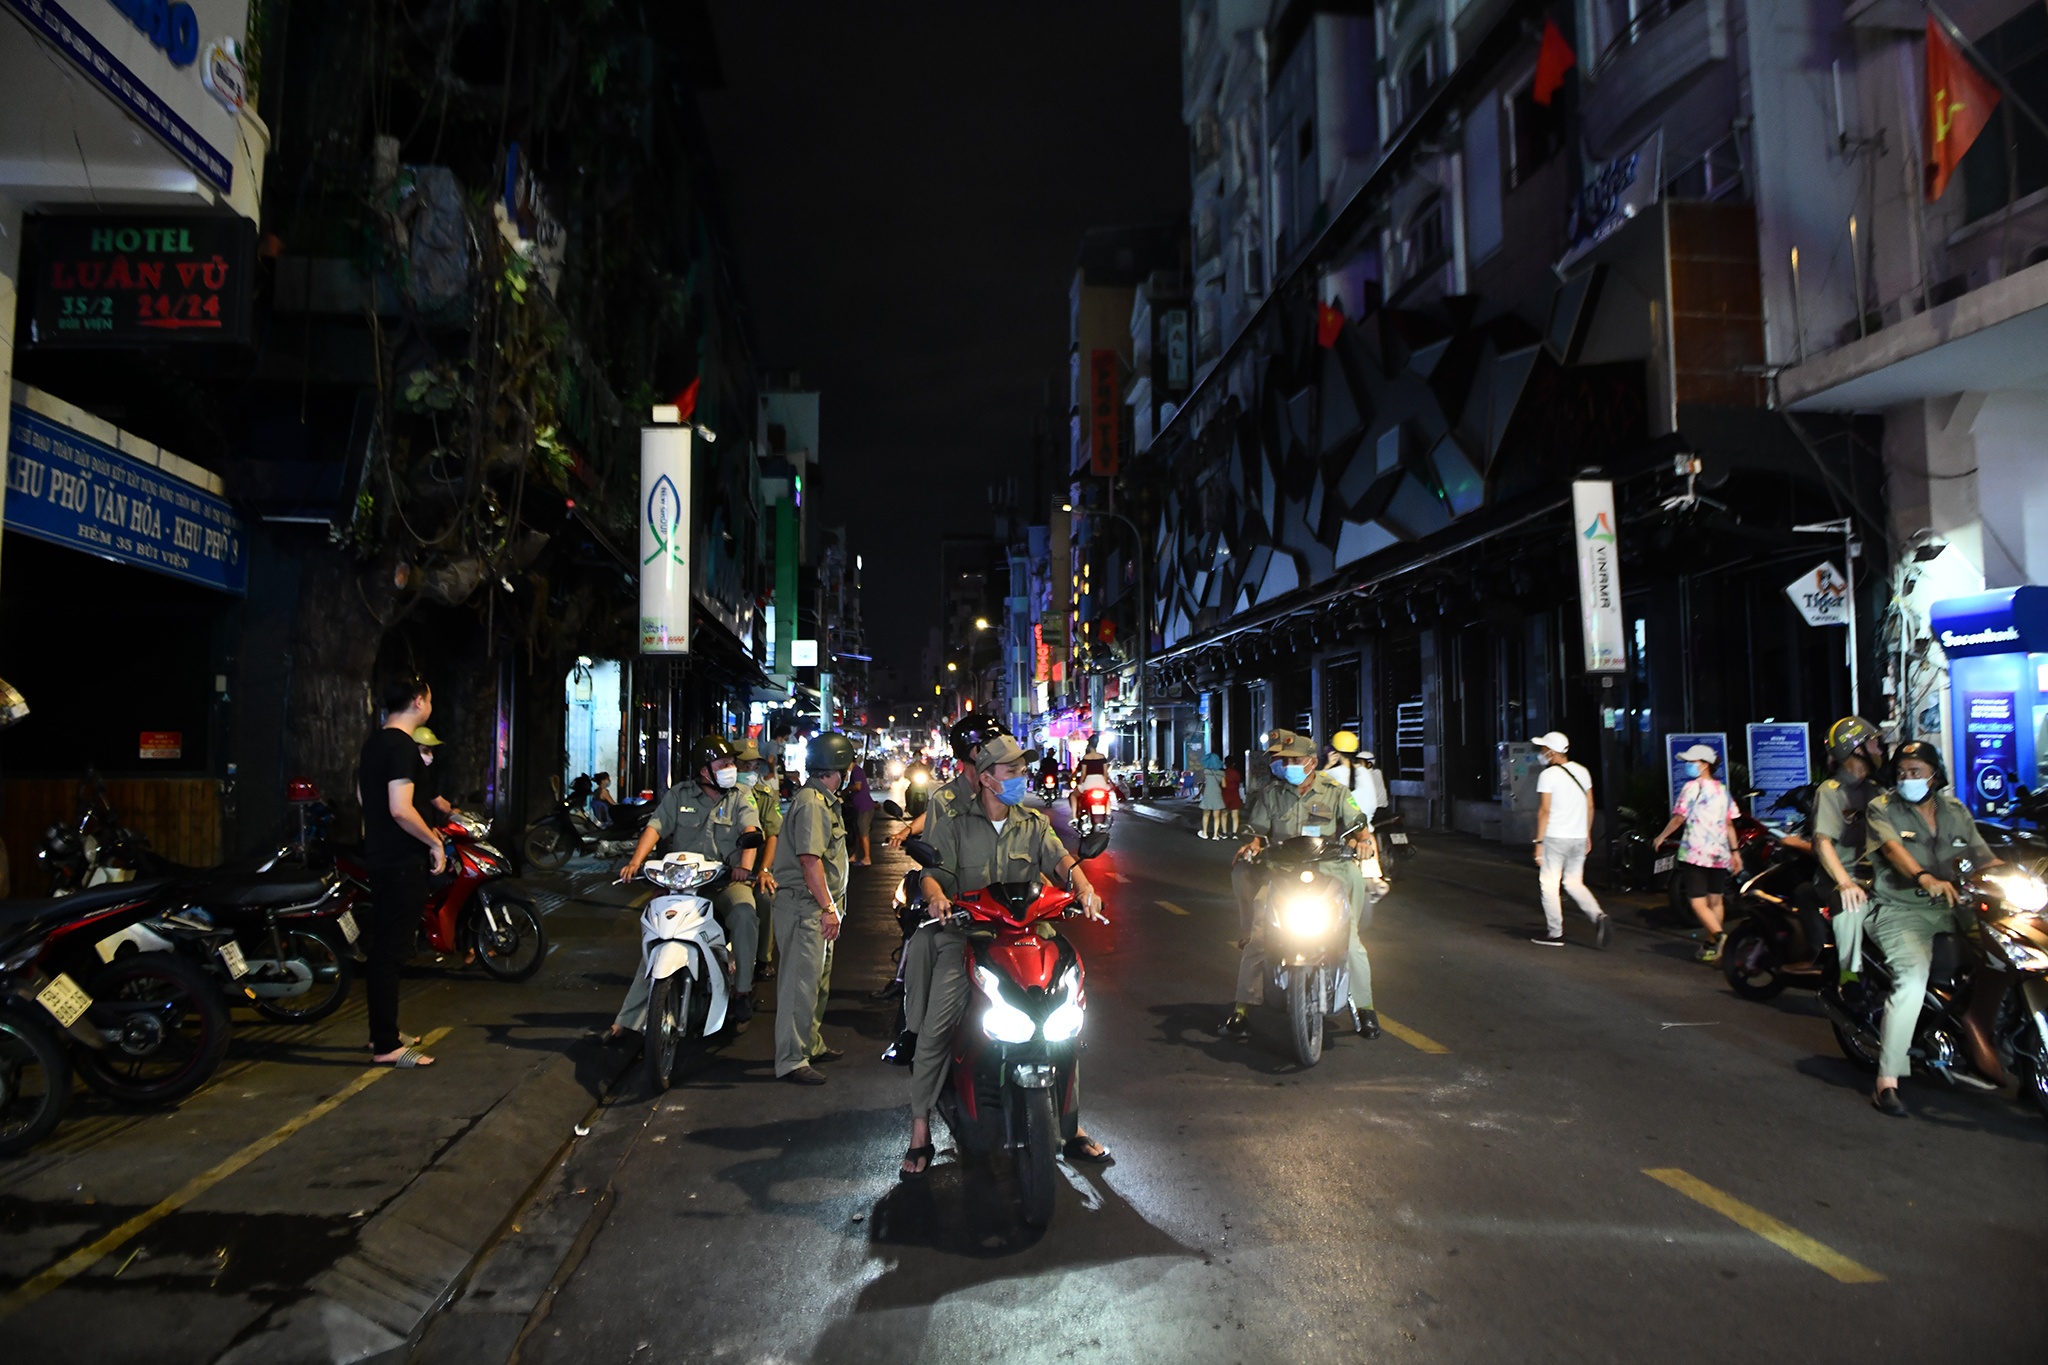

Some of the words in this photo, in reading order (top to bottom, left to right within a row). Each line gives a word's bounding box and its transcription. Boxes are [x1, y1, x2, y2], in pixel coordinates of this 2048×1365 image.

[90, 228, 194, 253] HOTEL
[62, 296, 113, 316] 35/2
[137, 294, 220, 317] 24/24
[48, 468, 93, 514] PHỐ
[93, 481, 129, 528] VĂN
[129, 496, 163, 540] HÓA
[173, 515, 203, 553] KHU
[203, 527, 233, 562] PHỐ
[231, 538, 240, 566] 3
[115, 535, 133, 551] 35
[136, 541, 159, 558] BÙI
[161, 548, 190, 570] VIỆN
[1803, 592, 1845, 614] Tiger
